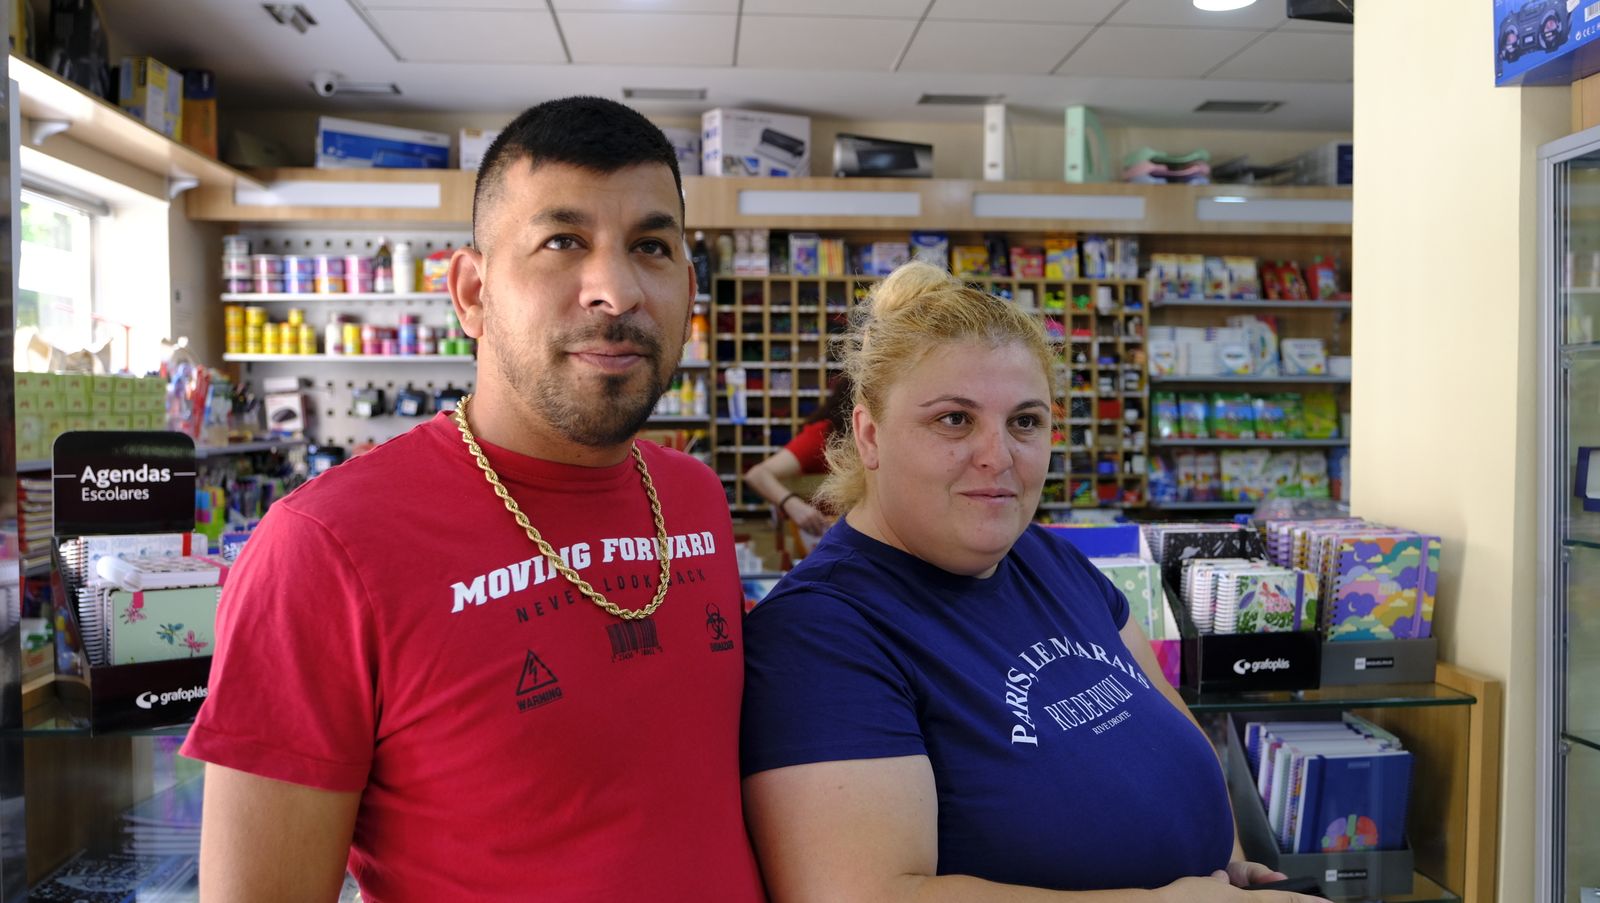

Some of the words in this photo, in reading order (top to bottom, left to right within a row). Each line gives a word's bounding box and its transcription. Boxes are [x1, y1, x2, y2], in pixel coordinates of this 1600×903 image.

[80, 463, 171, 489] Agendas
[81, 486, 150, 502] Escolares
[516, 589, 592, 624] NEVE
[603, 574, 652, 592] LOOK
[667, 568, 706, 587] ACK
[1018, 641, 1056, 672] LE
[1048, 635, 1150, 689] MARAIS
[1005, 667, 1039, 748] PARIS,
[1070, 692, 1103, 721] DE
[1085, 674, 1133, 713] RIVOLI
[1043, 699, 1087, 731] RUE
[1092, 722, 1111, 735] RIVE
[1107, 710, 1132, 728] DROITE
